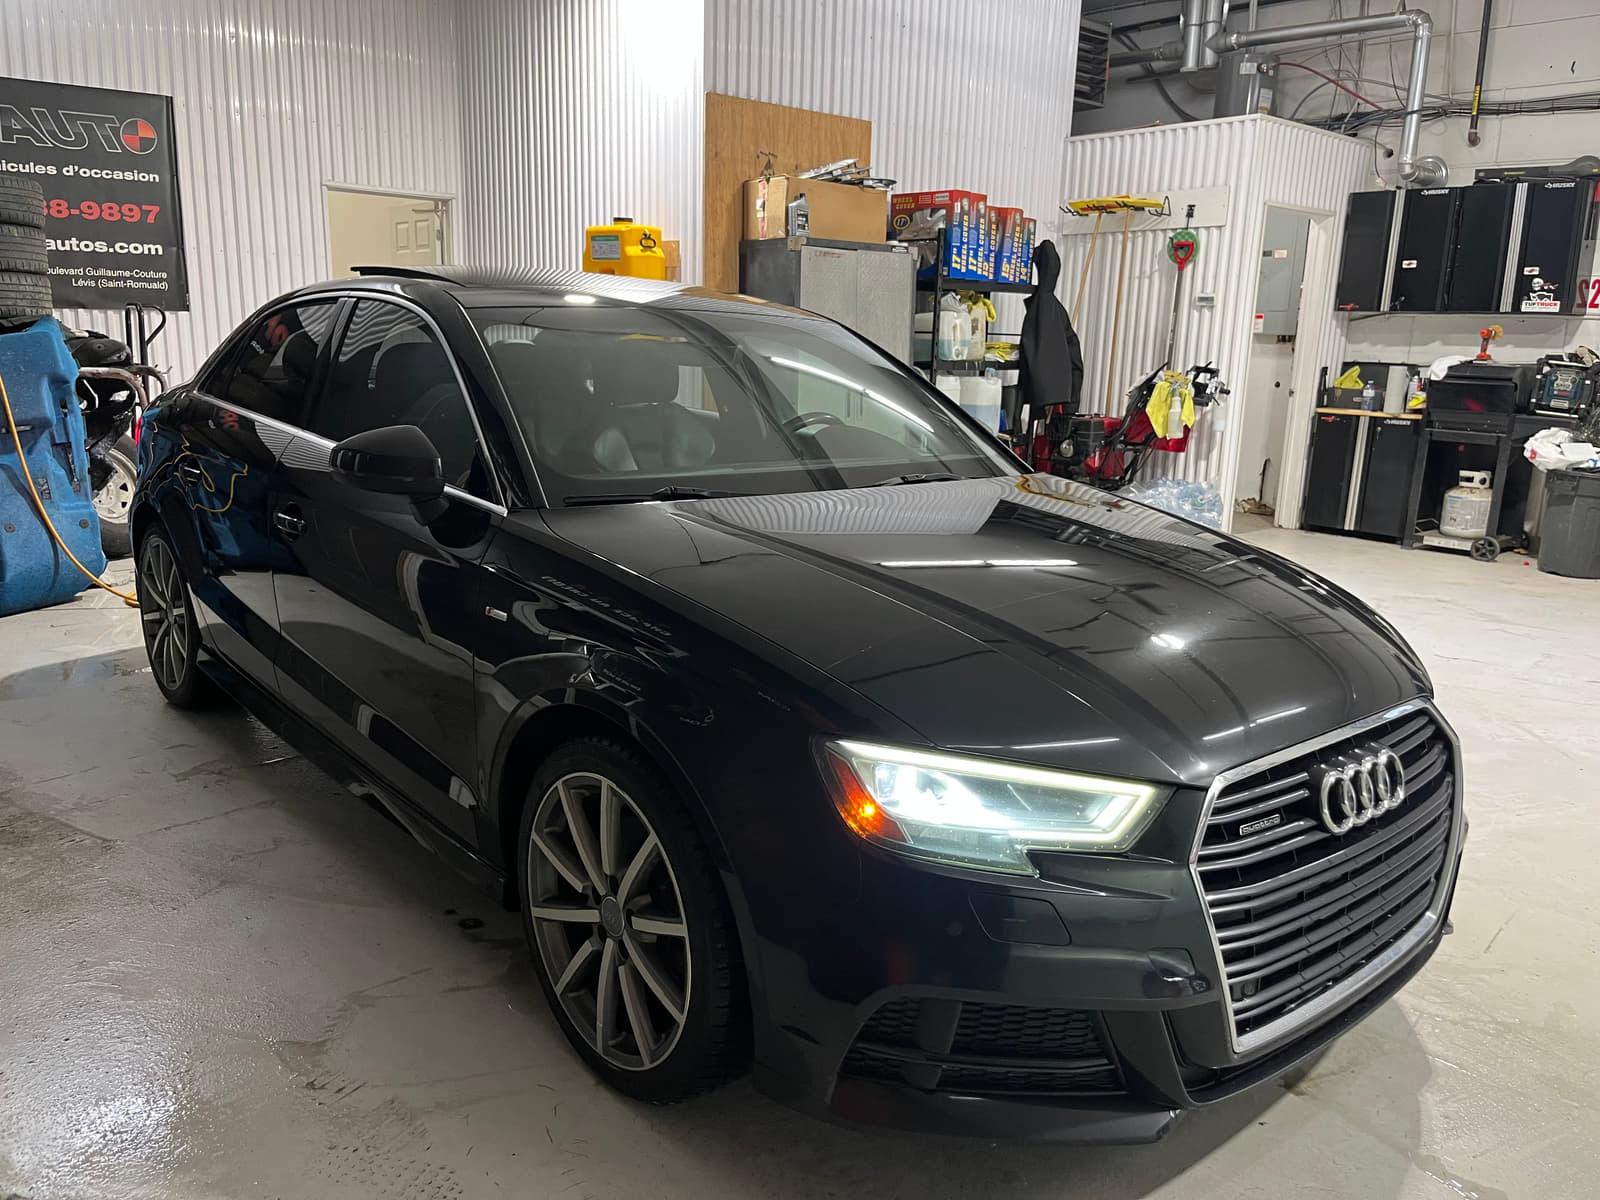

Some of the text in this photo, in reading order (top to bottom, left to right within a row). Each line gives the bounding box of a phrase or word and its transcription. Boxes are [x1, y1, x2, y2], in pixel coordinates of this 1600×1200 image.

[0, 160, 160, 183] icules d'occasion
[85, 267, 168, 279] Guillaume-Couture
[72, 278, 169, 291] Lévis (Saint-Romuald)
[1243, 817, 1280, 834] quattro
